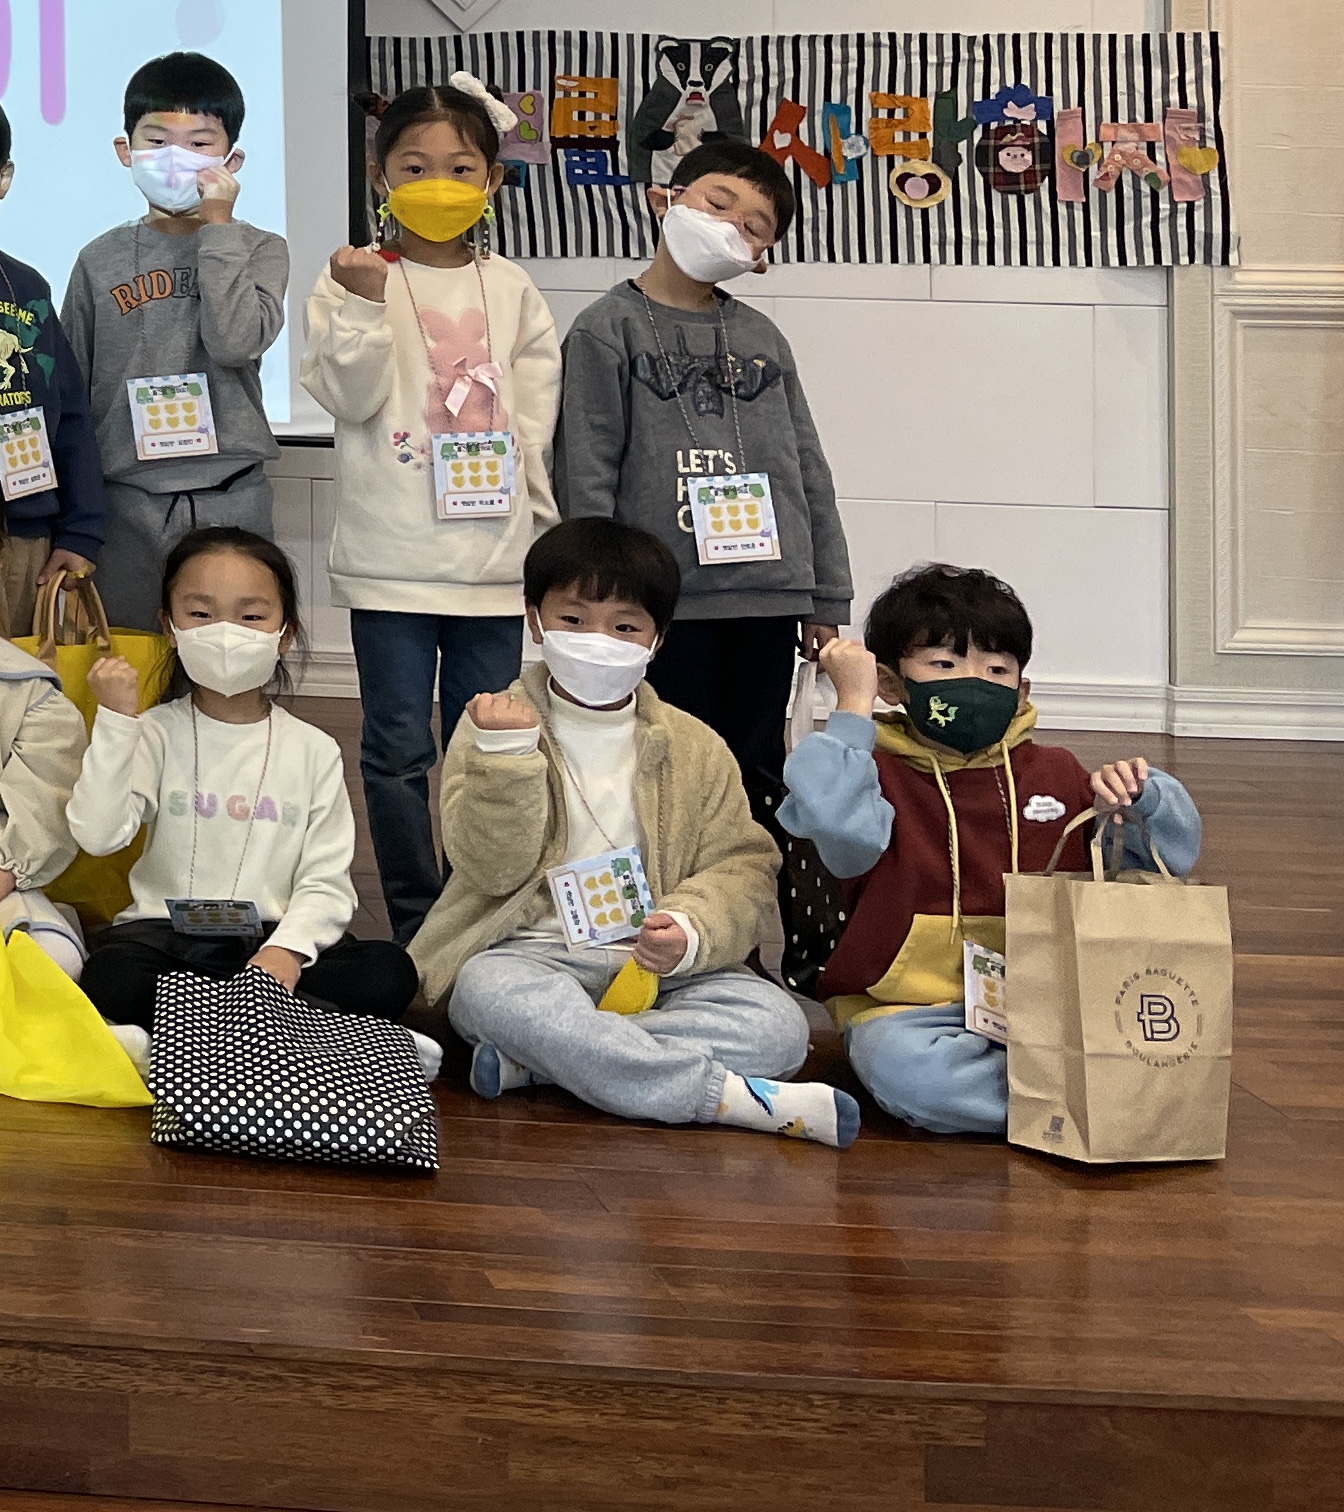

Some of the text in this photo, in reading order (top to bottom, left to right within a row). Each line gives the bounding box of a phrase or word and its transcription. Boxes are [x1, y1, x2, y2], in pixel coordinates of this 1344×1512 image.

[18, 308, 35, 326] ME
[676, 448, 737, 474] LET'S
[168, 789, 301, 828] SUGAR
[1145, 967, 1200, 1008] BAGUETTE
